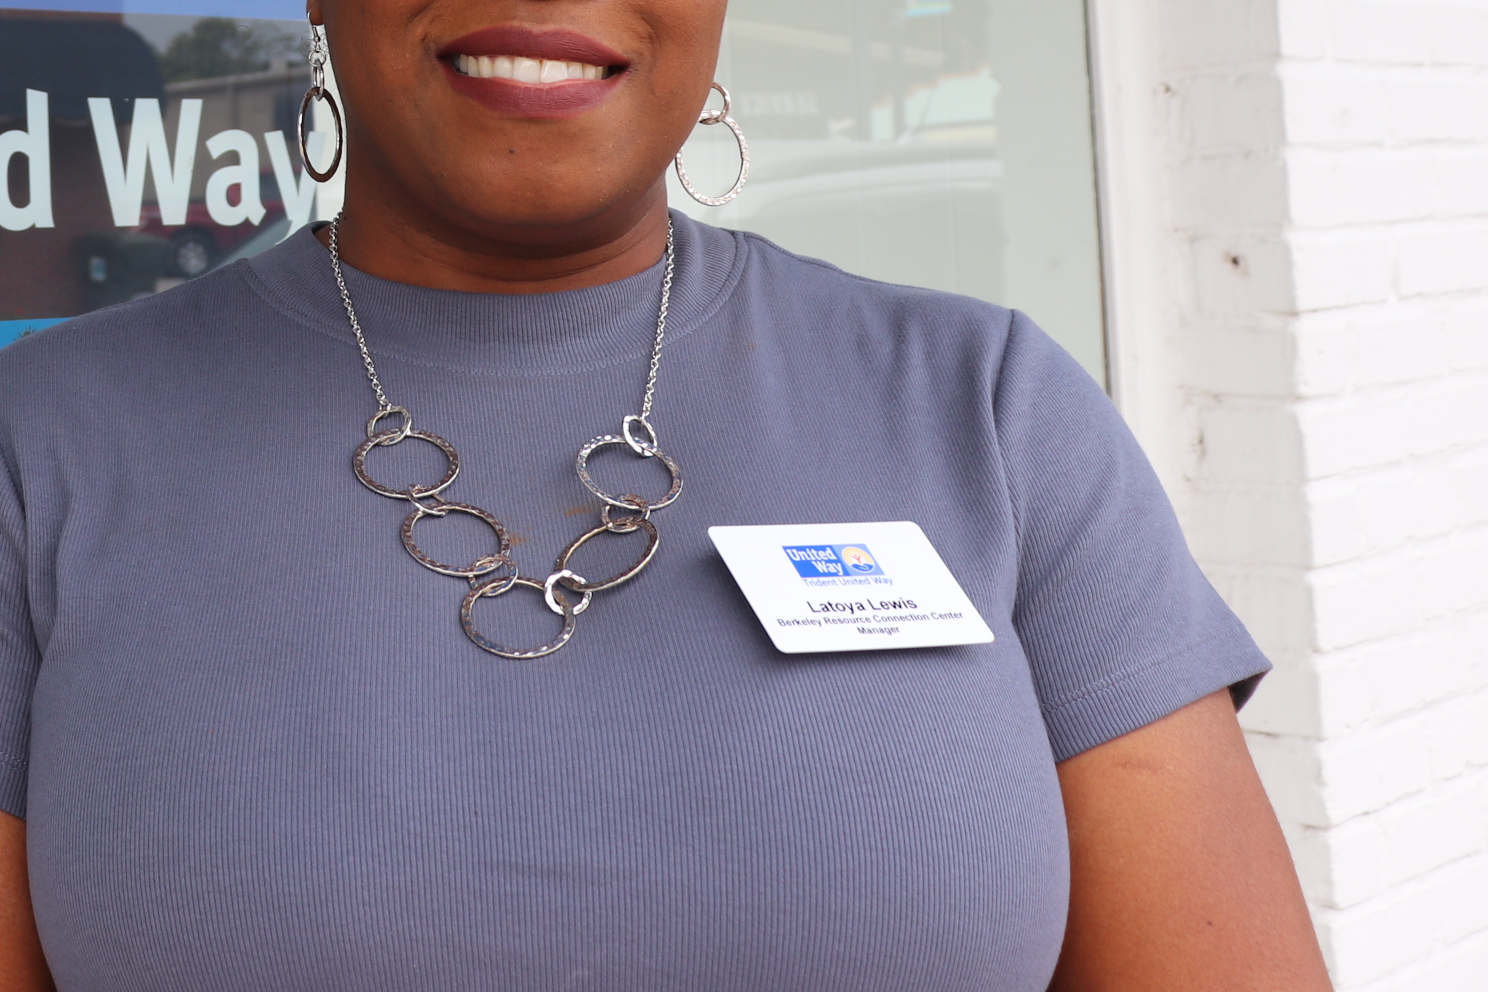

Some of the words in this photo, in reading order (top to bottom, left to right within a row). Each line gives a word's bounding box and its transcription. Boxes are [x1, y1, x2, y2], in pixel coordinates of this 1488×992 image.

[87, 97, 328, 246] Way
[785, 546, 839, 562] United
[811, 560, 844, 576] Way
[802, 577, 838, 588] Trident
[837, 576, 871, 587] United
[871, 574, 893, 586] Way
[806, 600, 866, 615] Latoya
[866, 596, 918, 611] Lewis
[776, 617, 822, 627] Berkeley
[823, 616, 872, 625] Resource
[872, 613, 930, 623] Connection
[930, 611, 964, 620] Center
[856, 625, 900, 636] Manager
